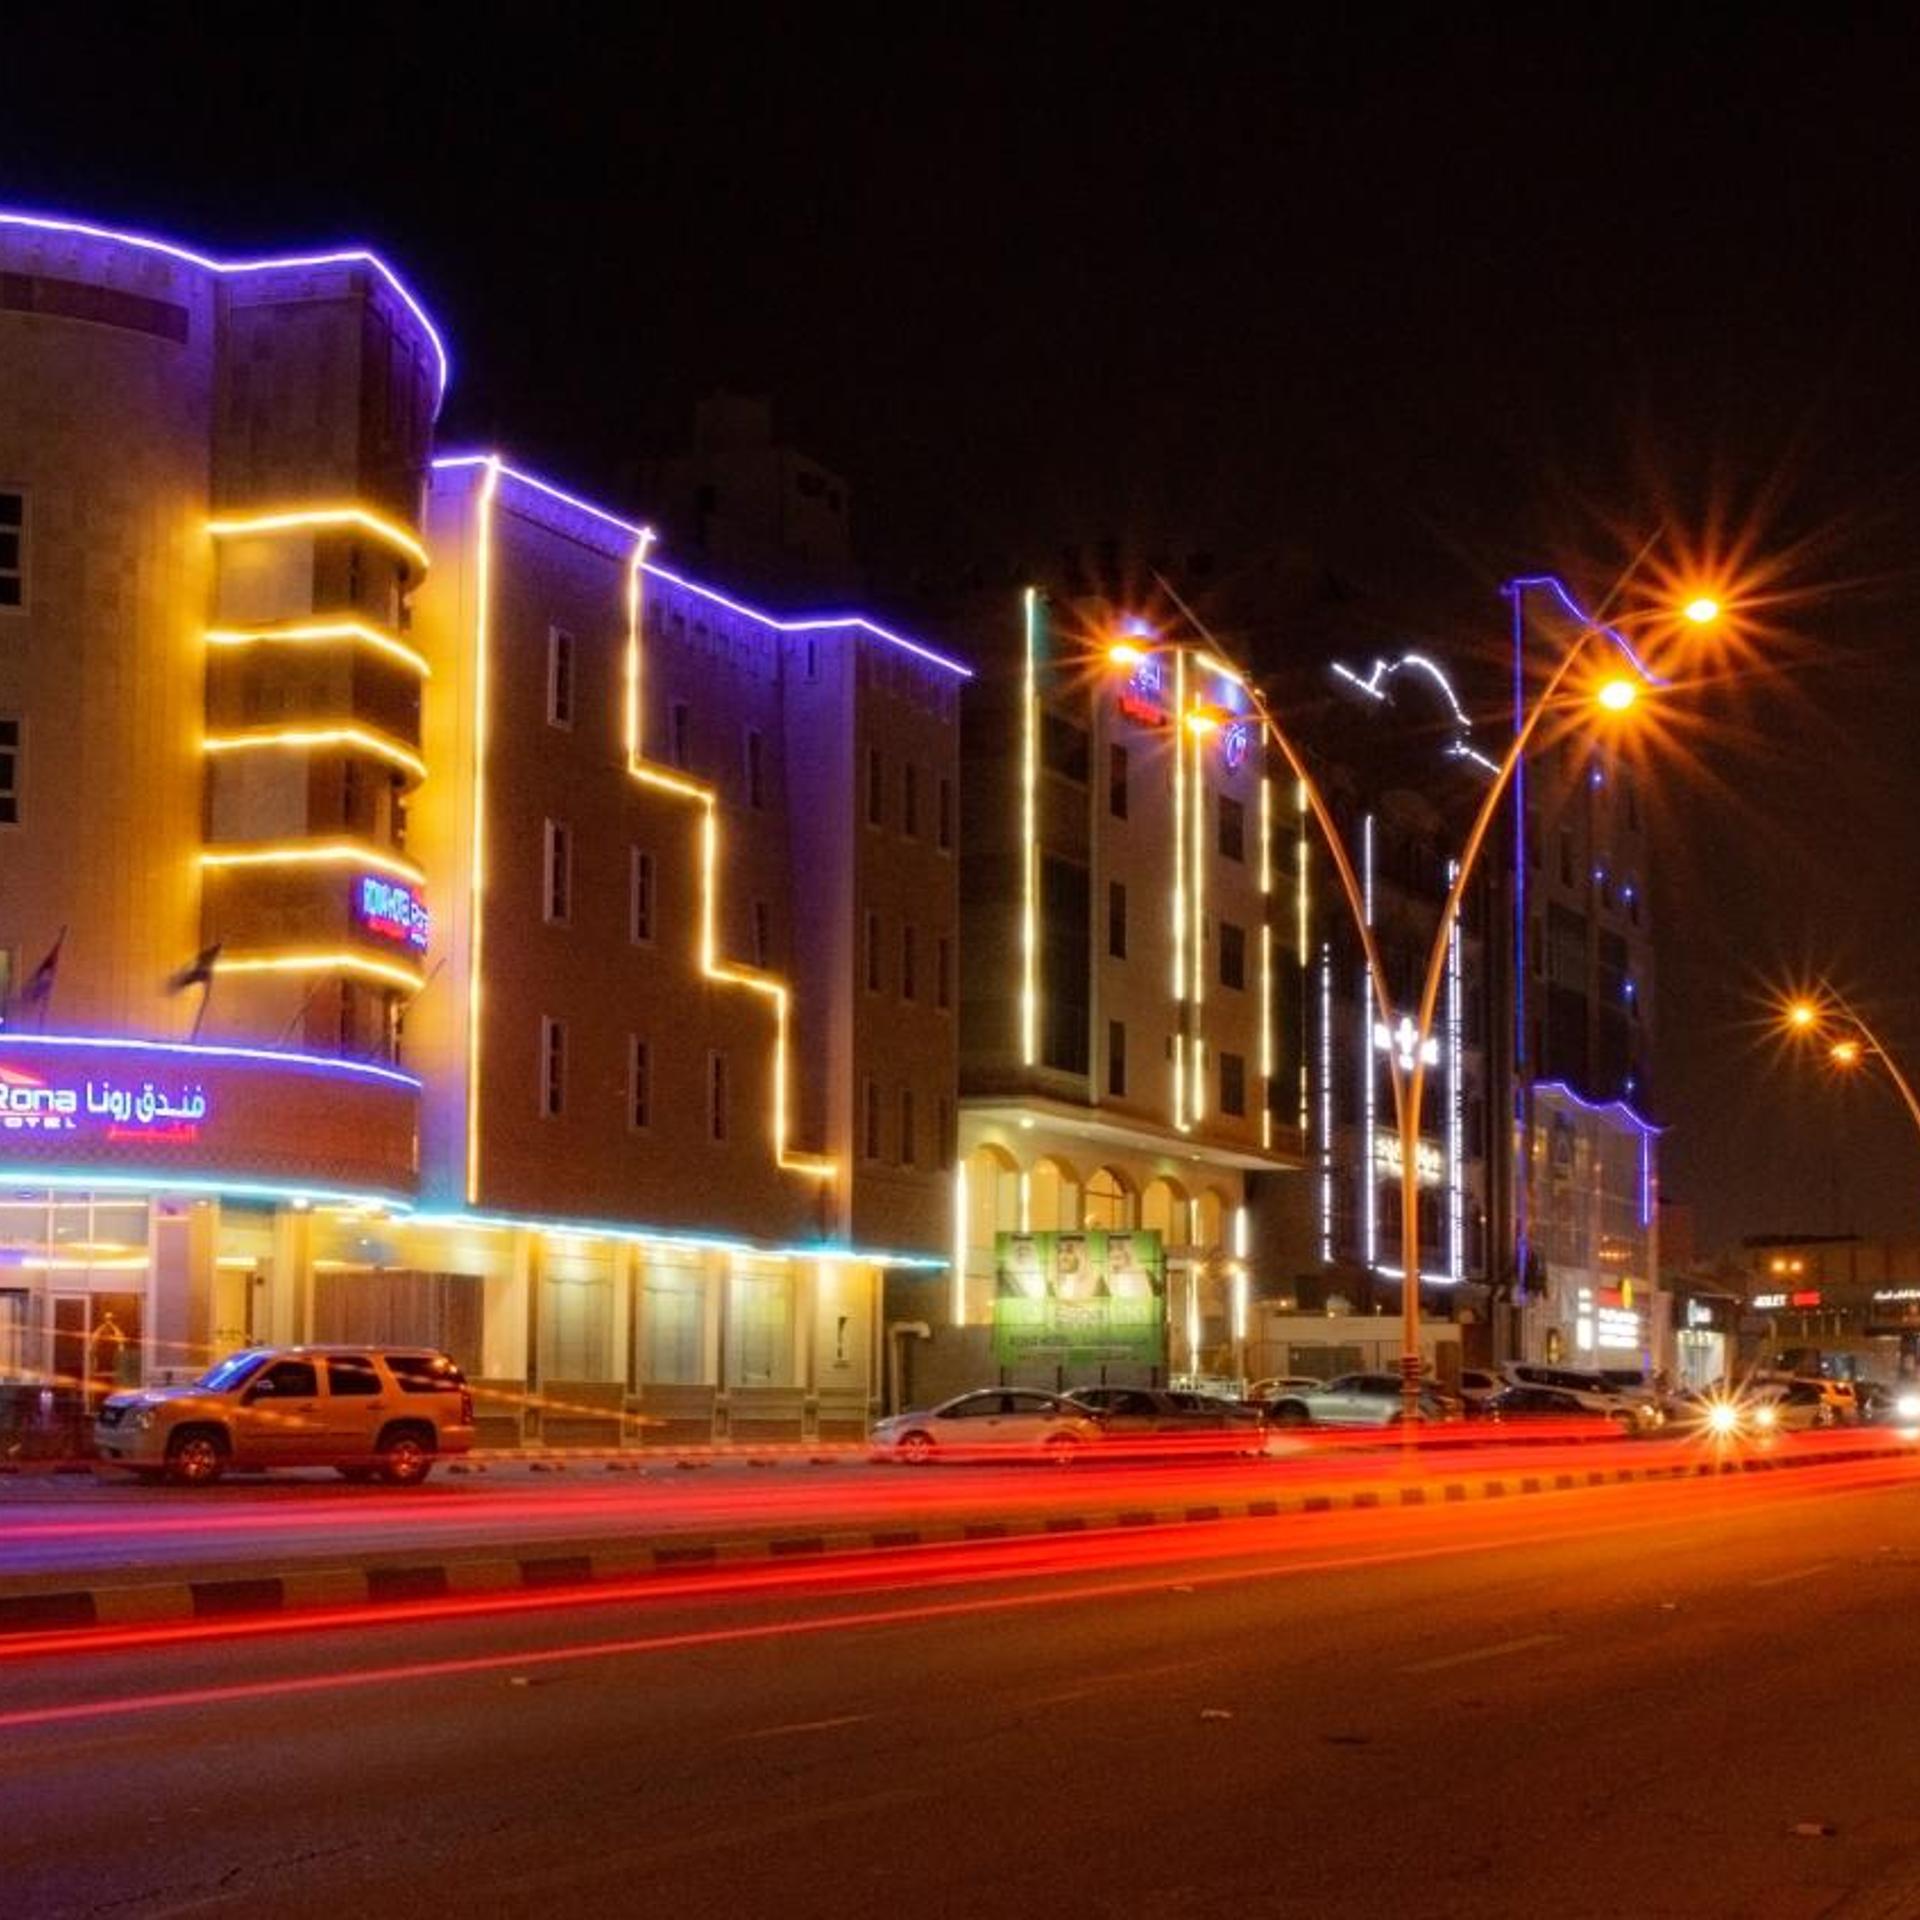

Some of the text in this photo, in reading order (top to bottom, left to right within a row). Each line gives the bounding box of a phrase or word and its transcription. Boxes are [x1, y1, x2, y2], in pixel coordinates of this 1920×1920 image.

[0, 1083, 76, 1112] Rona
[86, 1081, 205, 1123] فندق رونا
